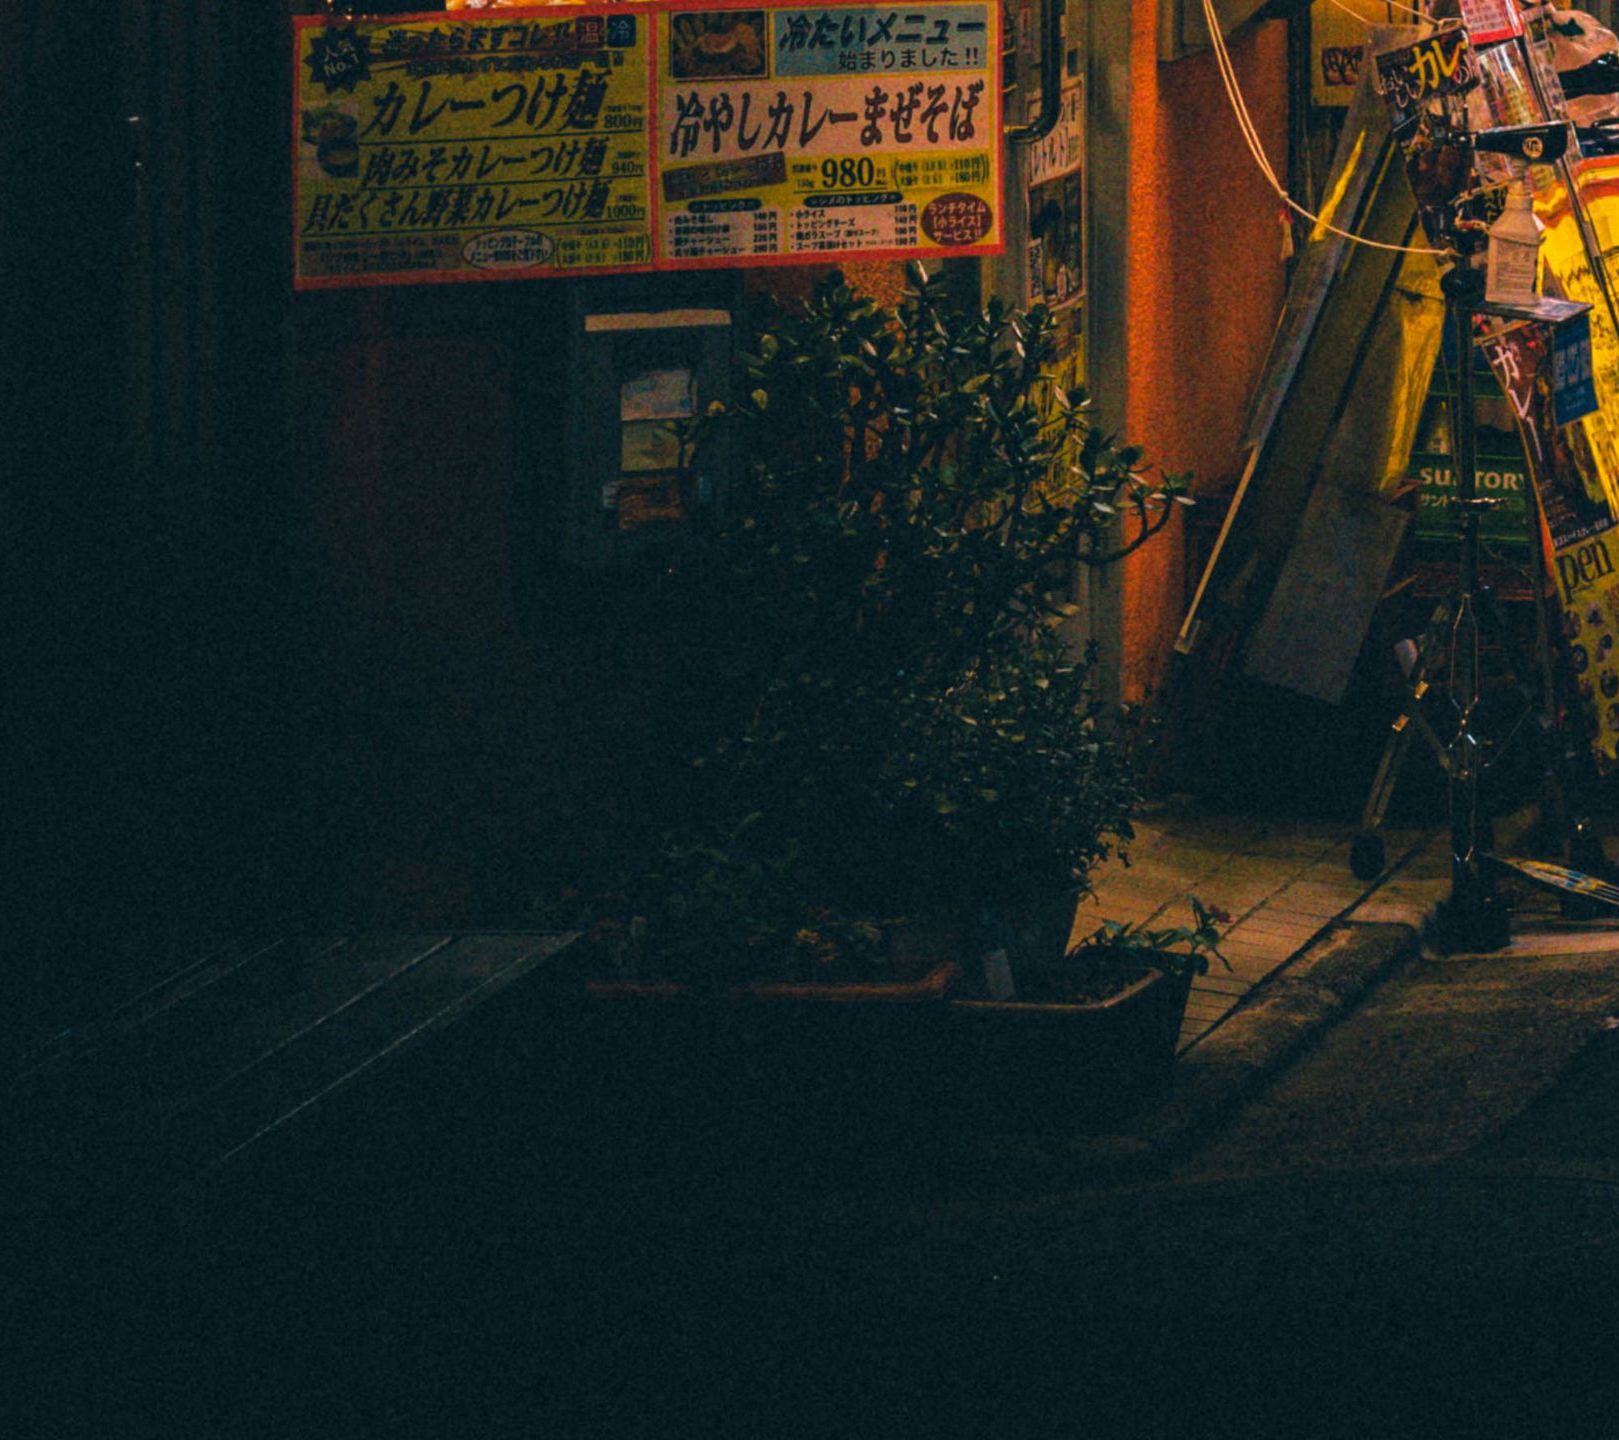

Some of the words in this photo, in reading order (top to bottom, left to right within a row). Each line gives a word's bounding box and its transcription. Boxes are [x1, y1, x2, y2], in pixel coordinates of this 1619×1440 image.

[779, 13, 985, 53] 冷たいメニュー
[359, 68, 612, 139] カレーつけ麺
[669, 79, 985, 158] 冷やしカレーまぜそば
[1556, 538, 1616, 605] pen
